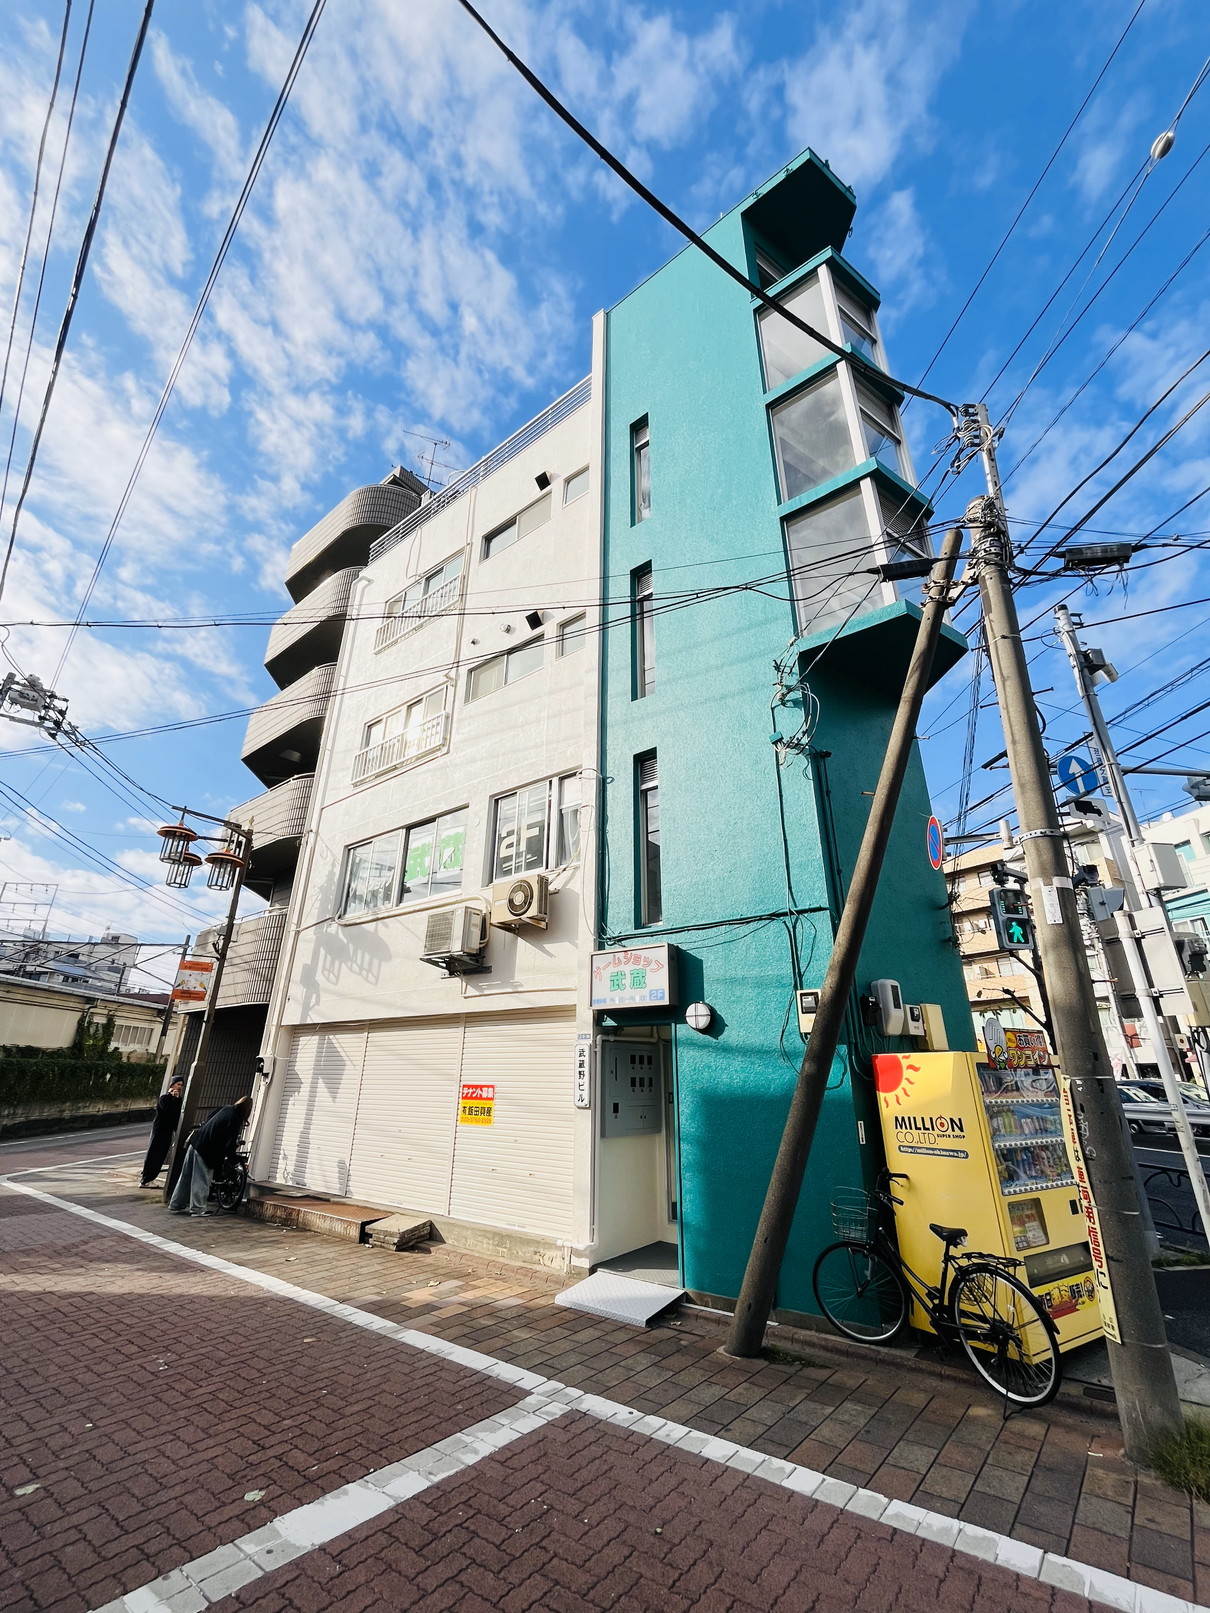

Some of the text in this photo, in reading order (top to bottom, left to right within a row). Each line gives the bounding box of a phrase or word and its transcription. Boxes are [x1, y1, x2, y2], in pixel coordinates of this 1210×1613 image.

[500, 812, 541, 858] 2F
[609, 967, 647, 992] 武蔵
[650, 990, 664, 1000] 2F
[1008, 1048, 1048, 1067] ワンコイン
[577, 1048, 586, 1103] 武蔵野ビル
[462, 1087, 493, 1097] テナント募集
[894, 1115, 964, 1132] MILLION
